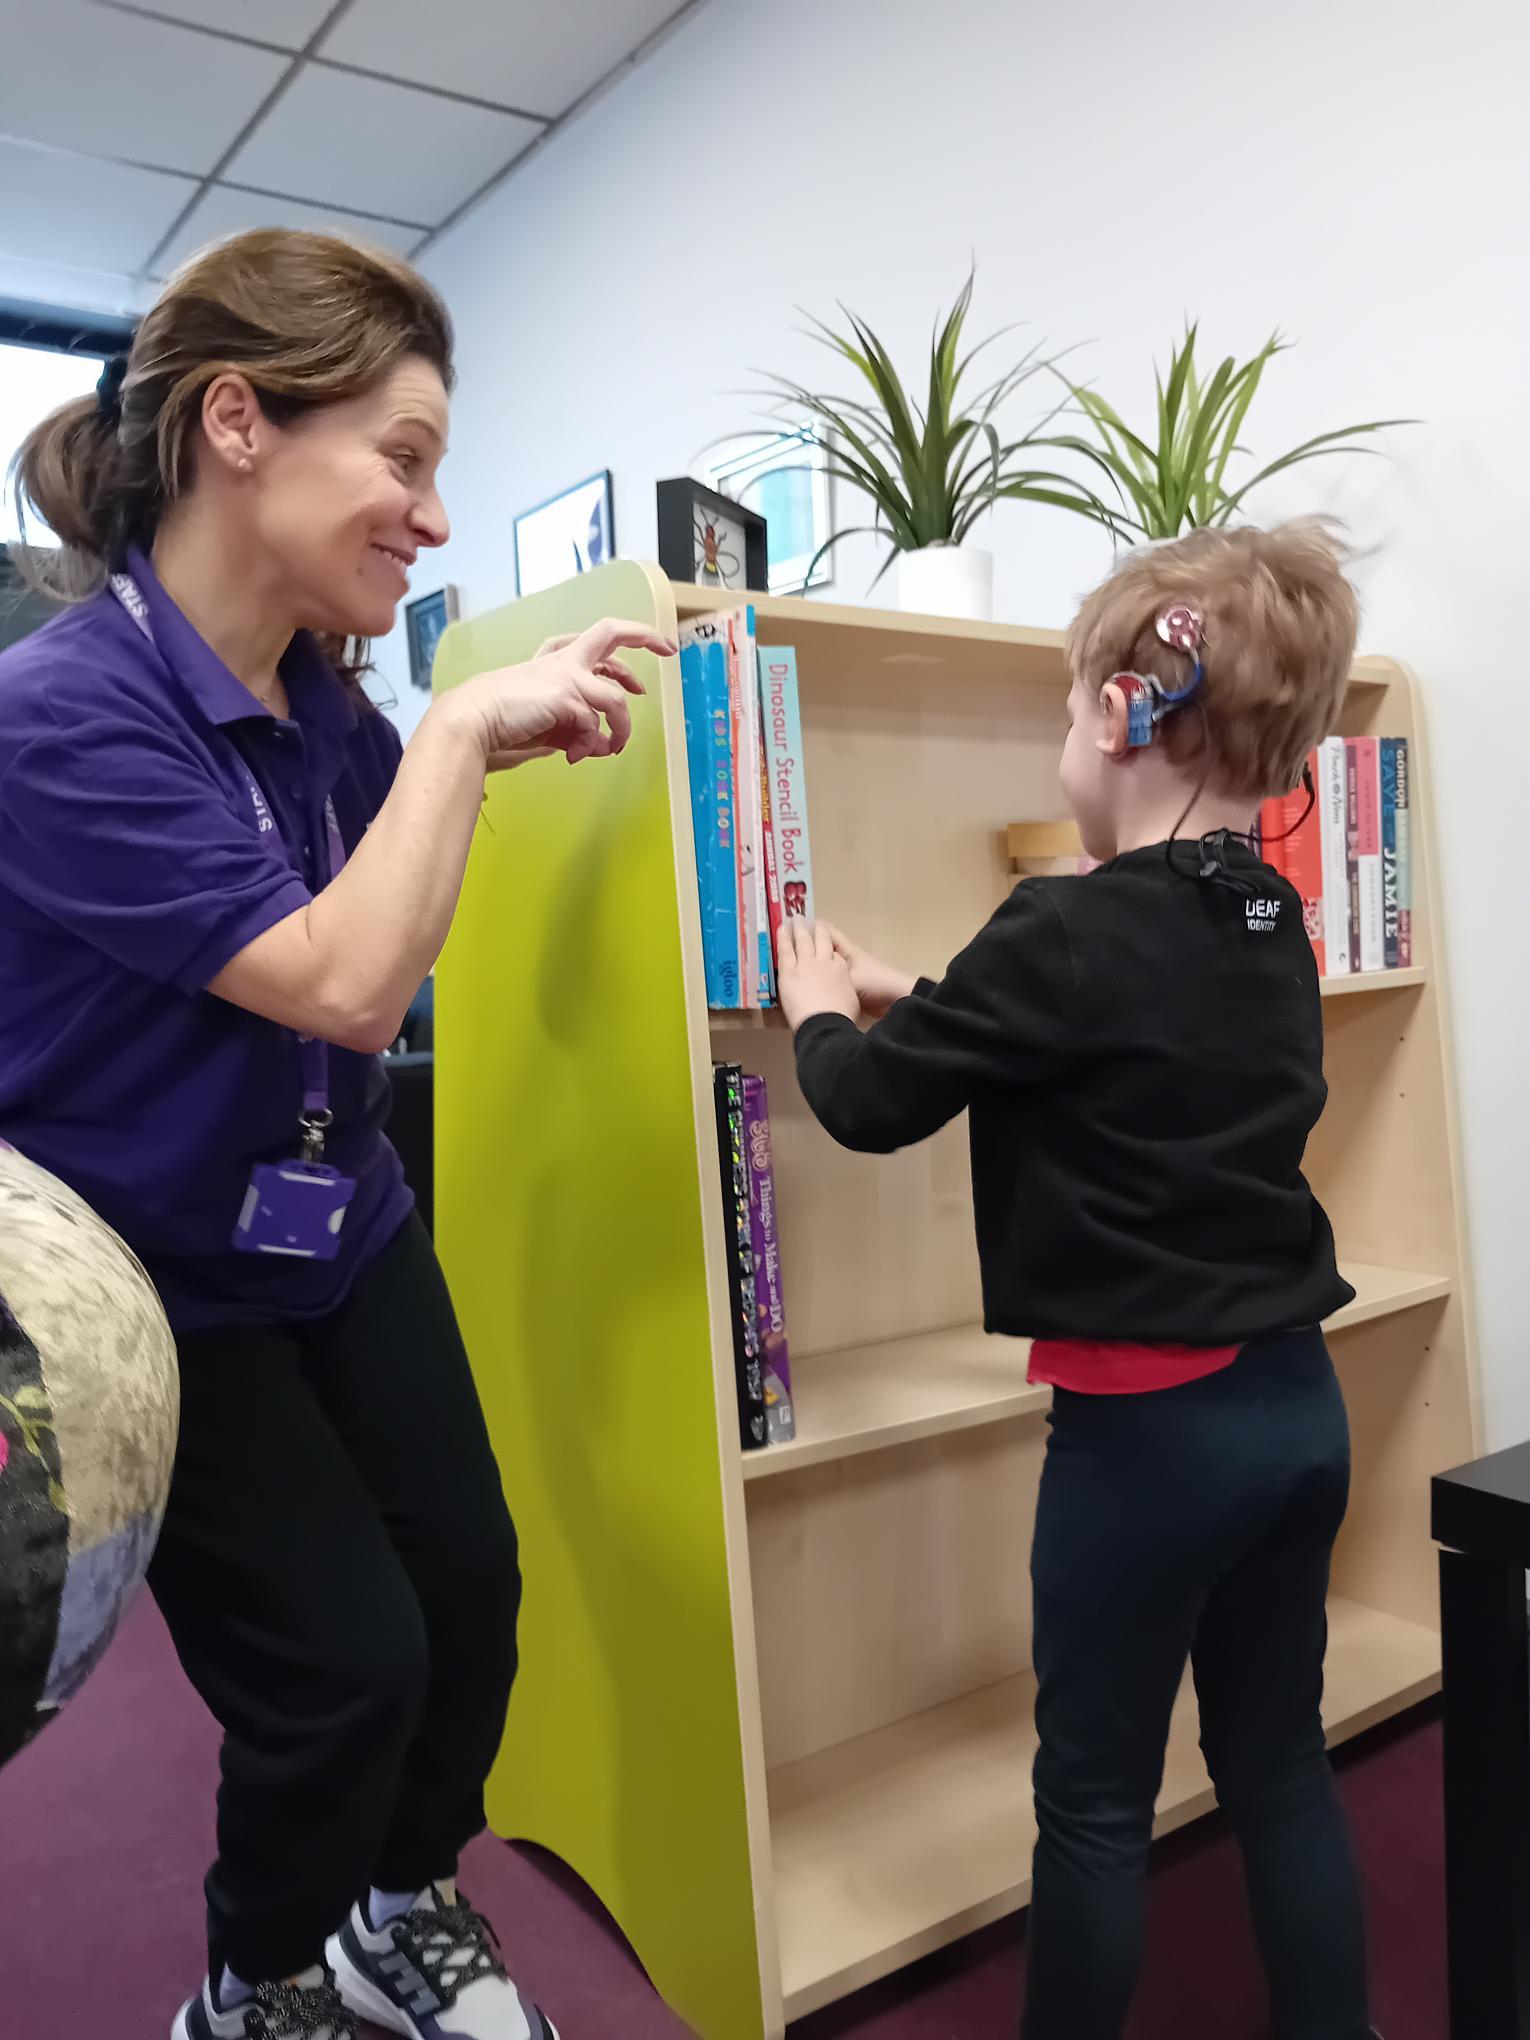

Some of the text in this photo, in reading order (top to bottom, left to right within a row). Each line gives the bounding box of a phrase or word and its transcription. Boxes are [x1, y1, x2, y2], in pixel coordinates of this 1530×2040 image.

[768, 663, 805, 874] Dinosaur Stencil Book
[1381, 749, 1395, 817] SAVE
[1395, 749, 1407, 808] GORDON
[1383, 847, 1398, 938] JAMIE
[719, 960, 736, 998] igloo
[749, 1119, 770, 1172] 365
[759, 1176, 776, 1228] Things
[763, 1229, 772, 1241] to
[765, 1242, 780, 1284] Make
